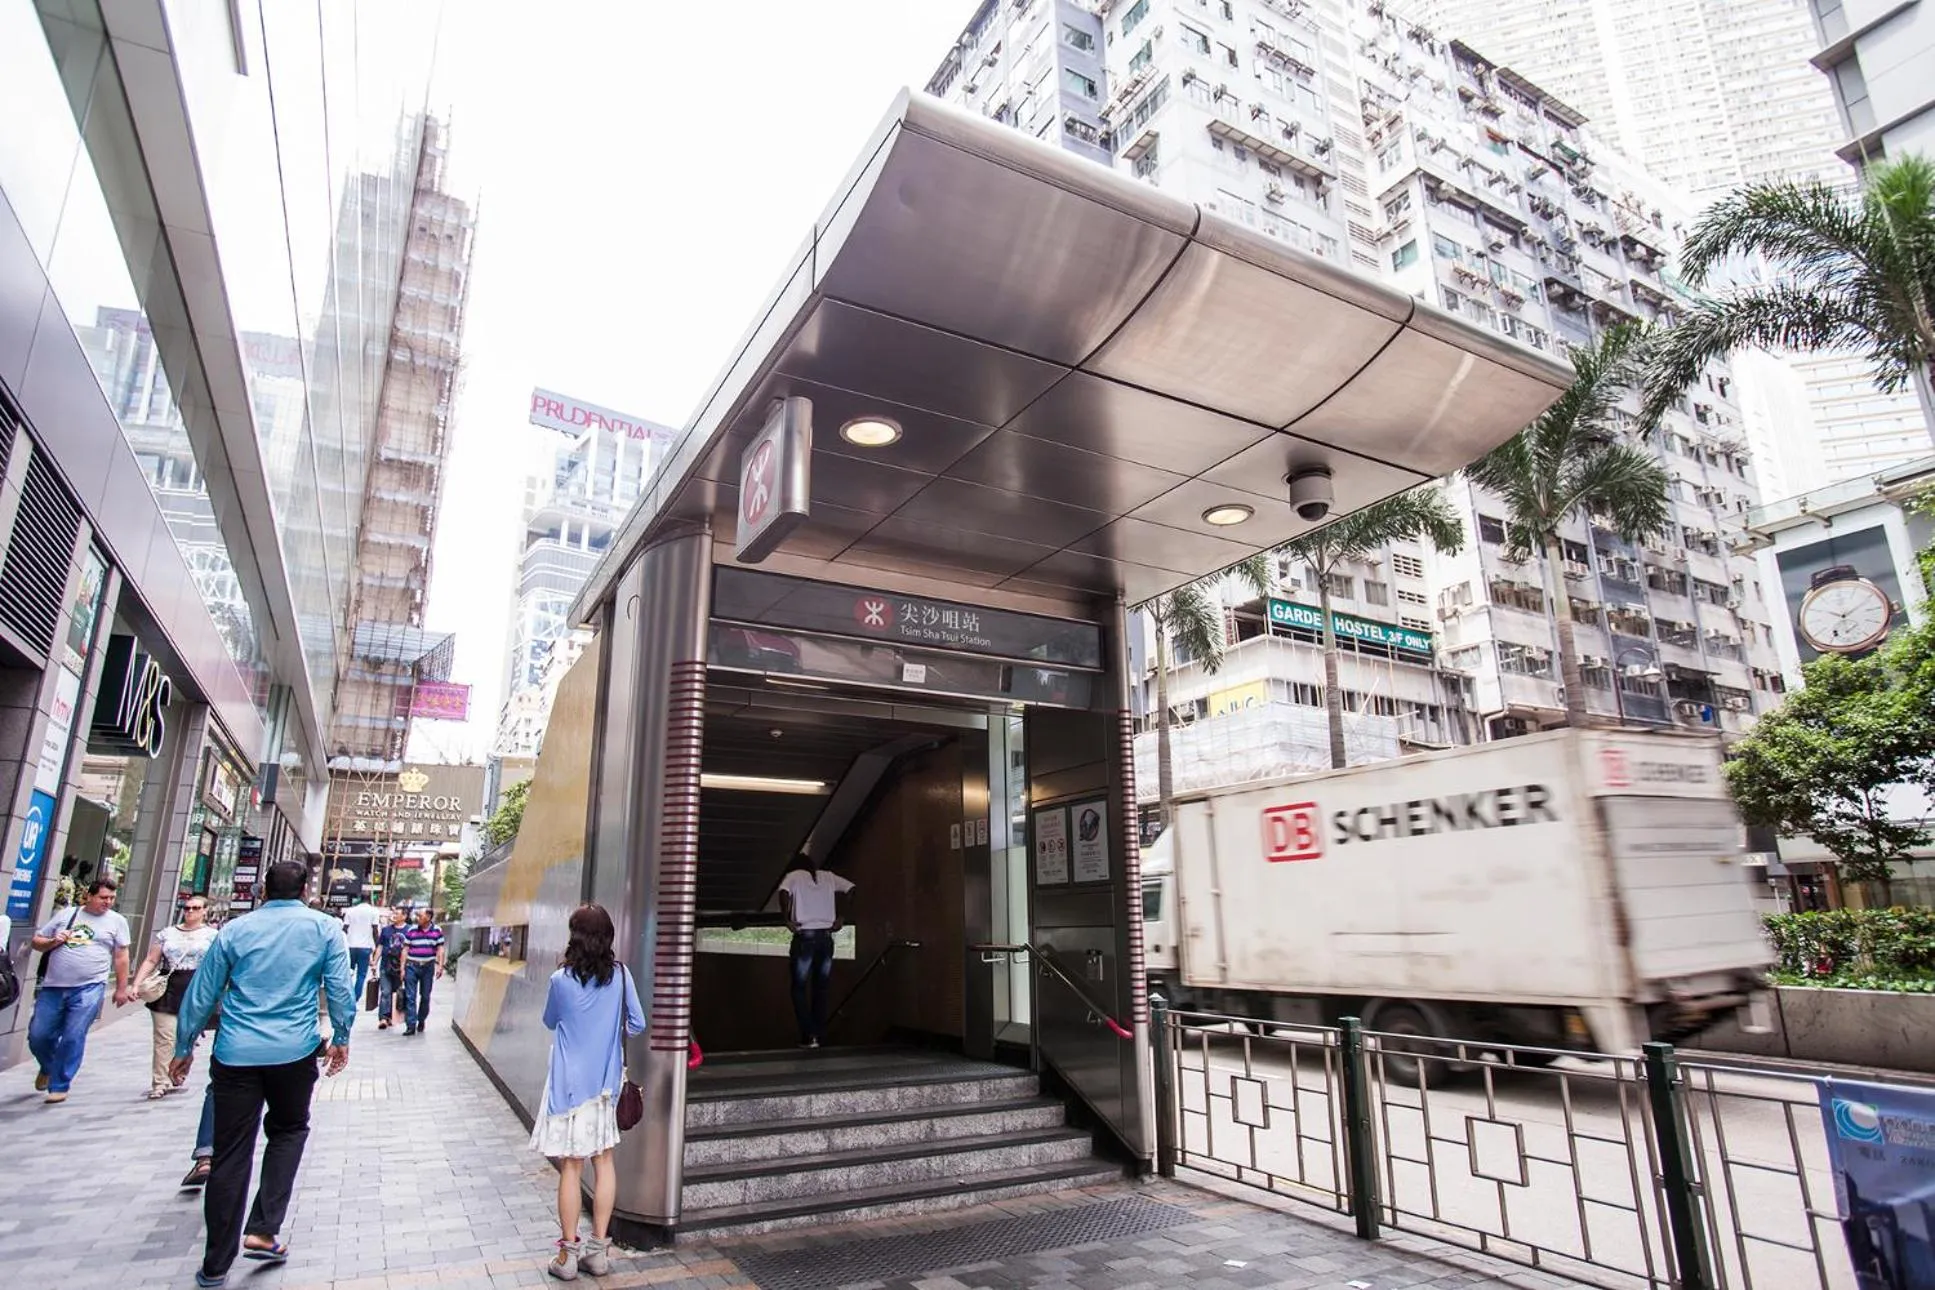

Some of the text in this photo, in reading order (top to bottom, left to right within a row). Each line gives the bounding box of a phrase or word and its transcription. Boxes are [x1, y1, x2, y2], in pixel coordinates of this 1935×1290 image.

[900, 602, 980, 633] 尖沙咀站
[1273, 604, 1323, 626] GARDE
[1335, 617, 1386, 641] HOSTEL
[1405, 635, 1432, 650] ONLY
[901, 625, 992, 648] Tsim Sha Tsui Station
[116, 636, 172, 760] M&S
[355, 809, 388, 818] WATCH
[391, 811, 411, 819] AND
[357, 791, 462, 812] EMPEROR
[1269, 782, 1560, 853] DB SCHENKER
[22, 820, 39, 850] UA
